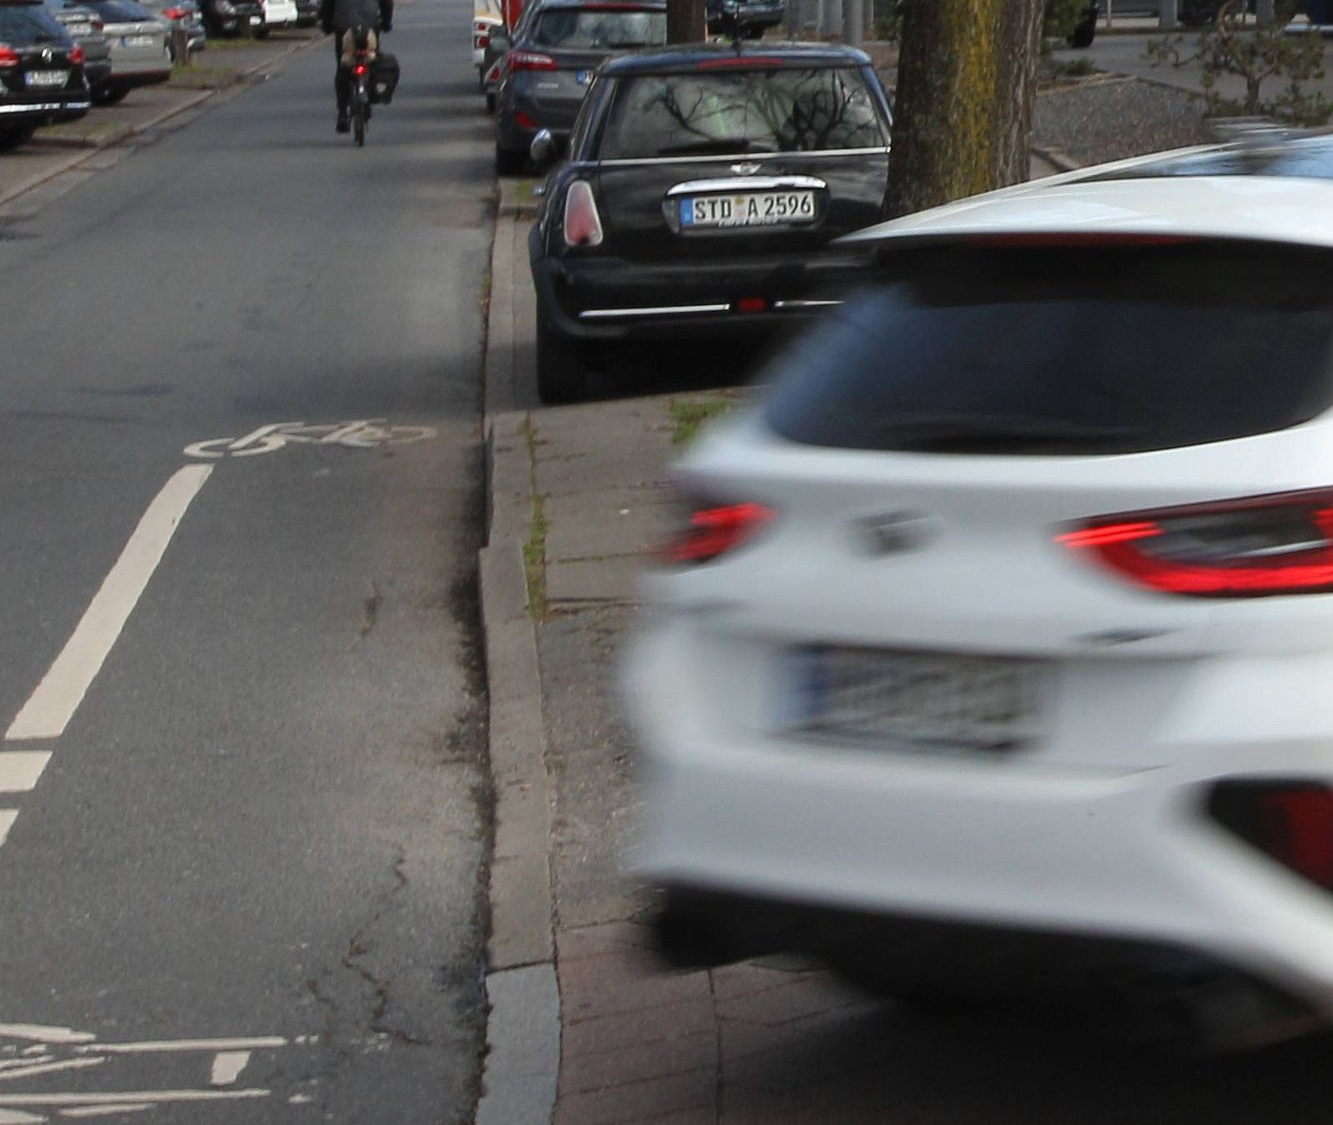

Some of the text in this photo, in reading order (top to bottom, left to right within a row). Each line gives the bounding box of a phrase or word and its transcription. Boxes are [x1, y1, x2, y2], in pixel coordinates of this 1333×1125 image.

[695, 193, 811, 219] STD A 2596
